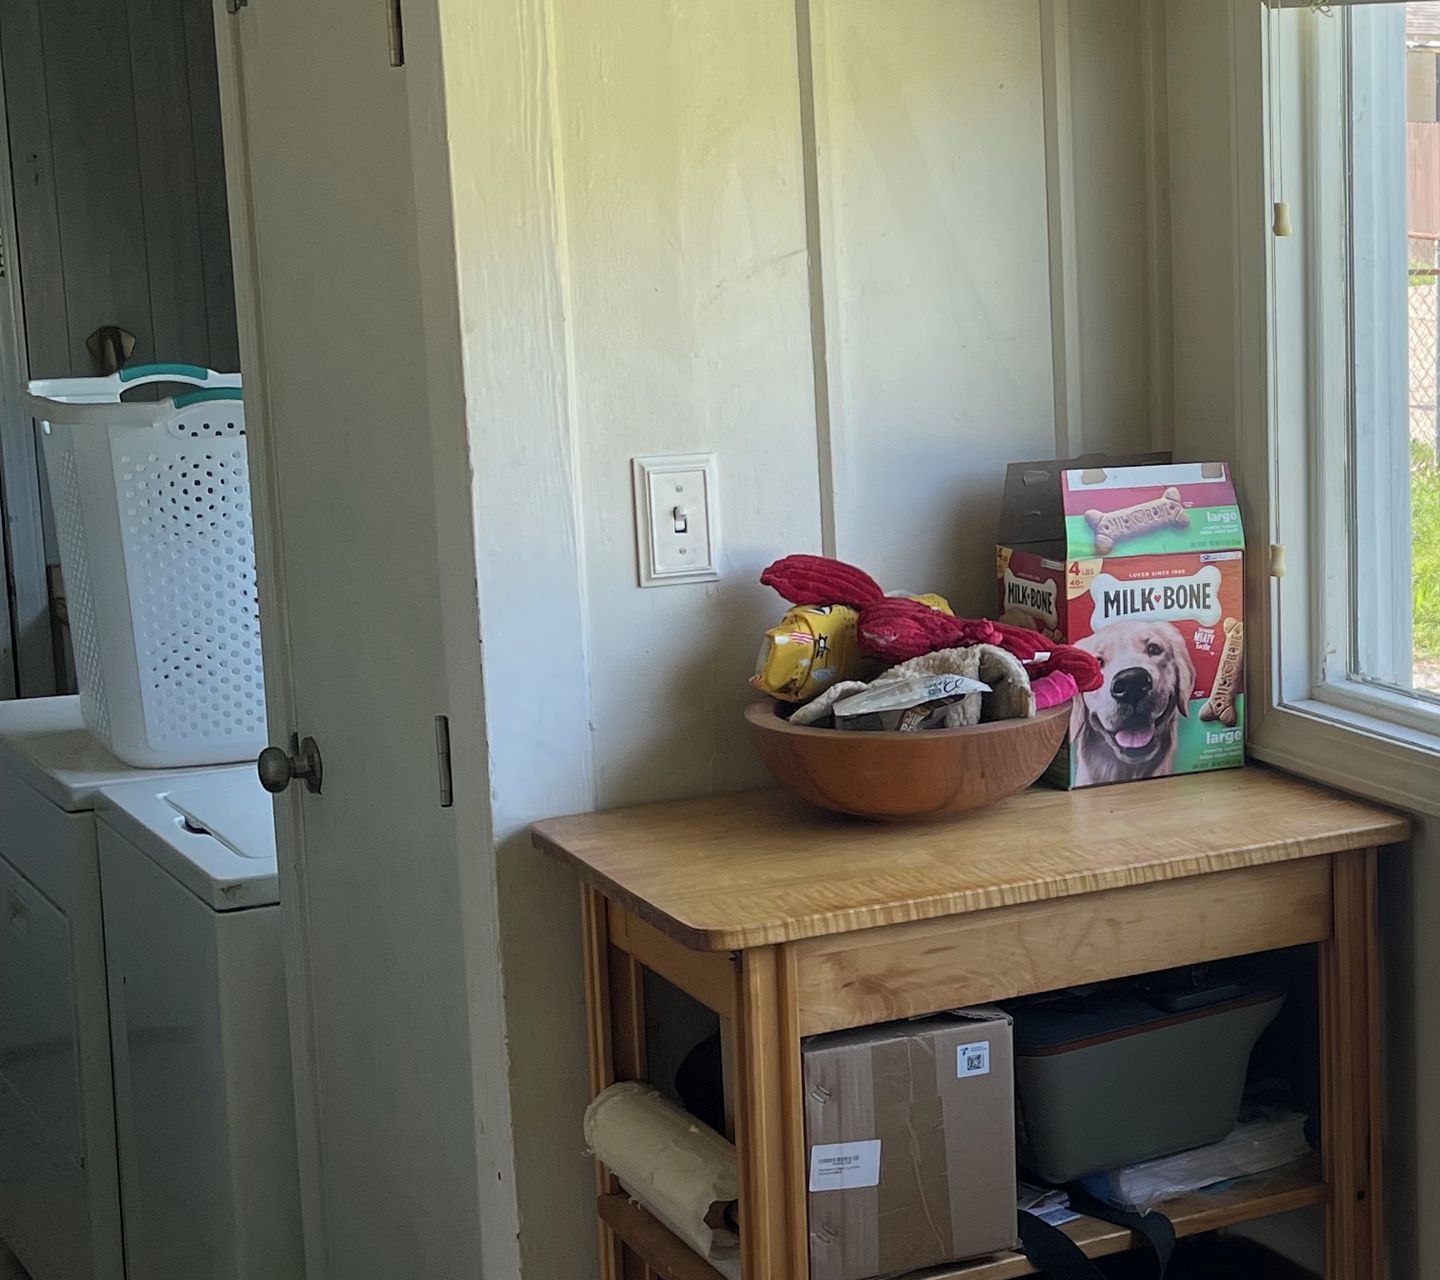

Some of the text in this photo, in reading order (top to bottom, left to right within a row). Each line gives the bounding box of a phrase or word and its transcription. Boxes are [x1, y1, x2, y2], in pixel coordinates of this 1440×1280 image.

[1207, 511, 1238, 523] large
[1068, 561, 1081, 576] 4
[1206, 730, 1242, 745] large
